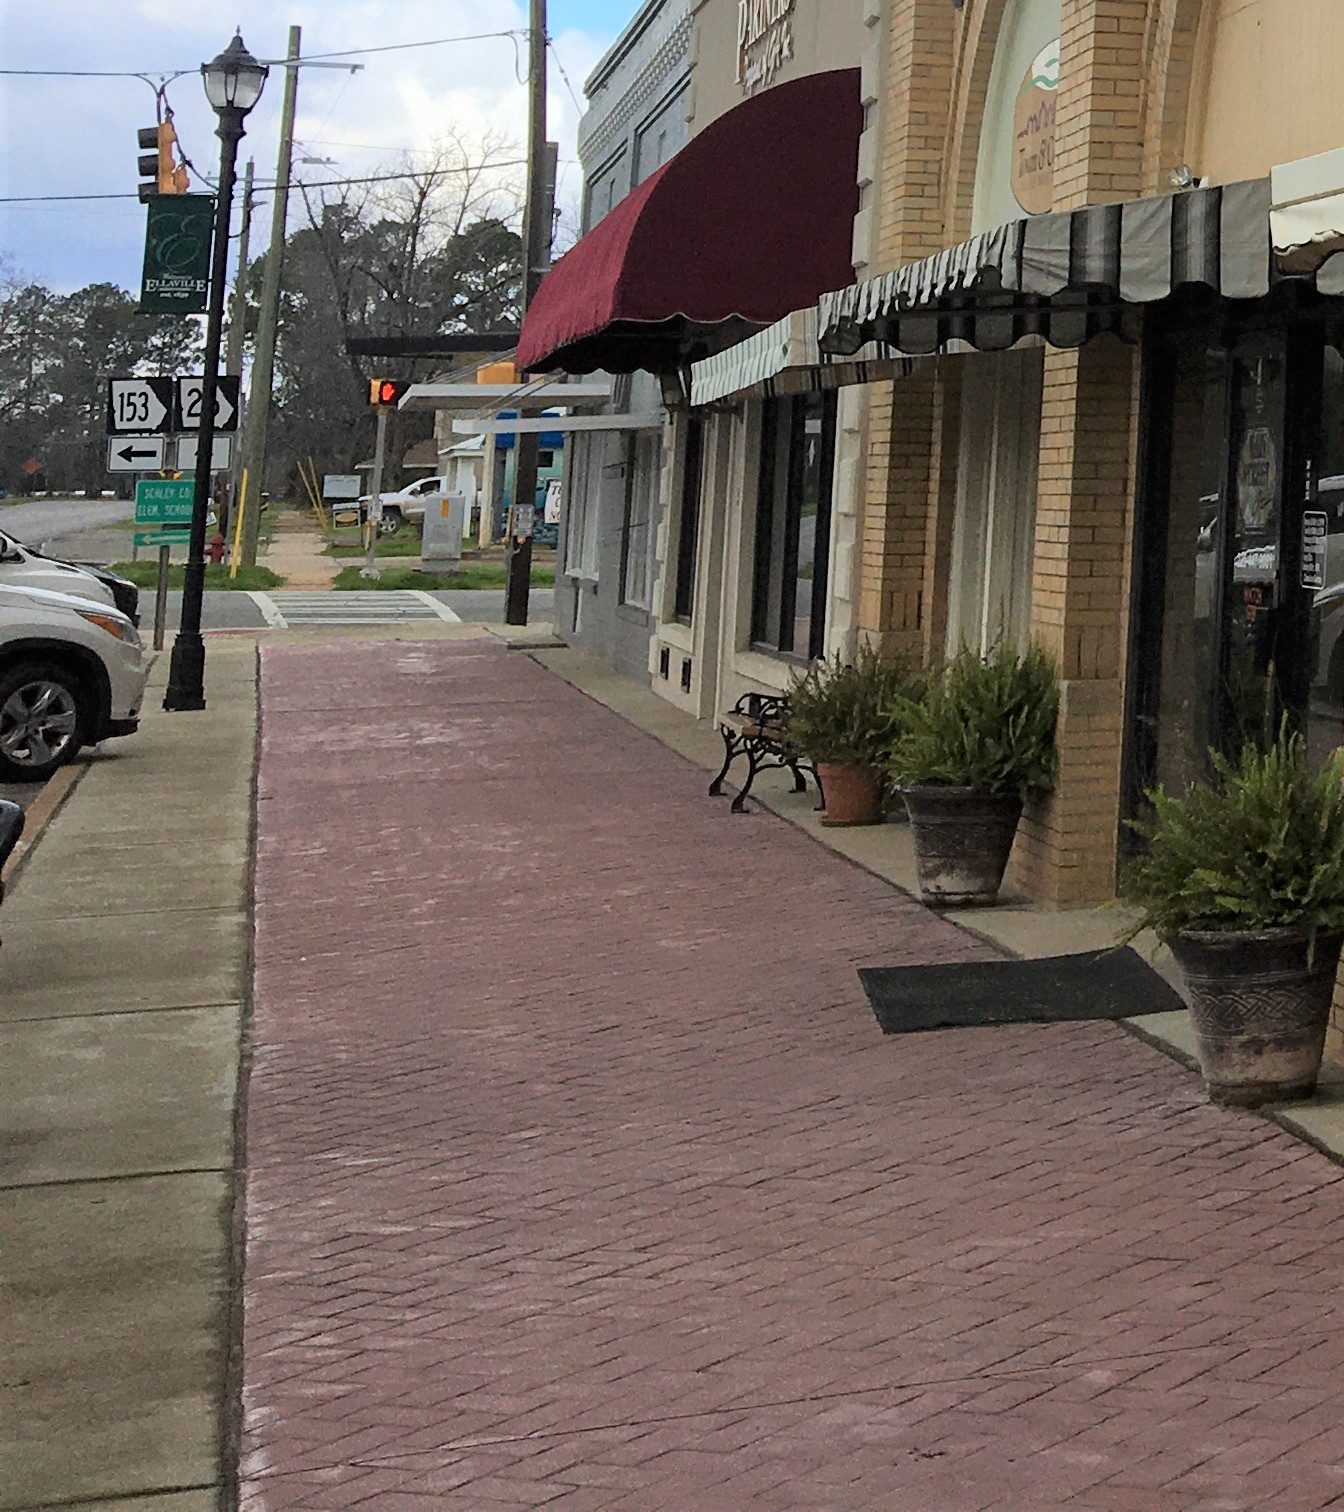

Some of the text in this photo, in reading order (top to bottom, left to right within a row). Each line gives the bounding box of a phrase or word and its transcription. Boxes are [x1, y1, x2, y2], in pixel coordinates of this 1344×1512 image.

[145, 278, 206, 292] ELLAVILLE
[118, 392, 149, 423] 153
[165, 504, 194, 517] SCHOO
